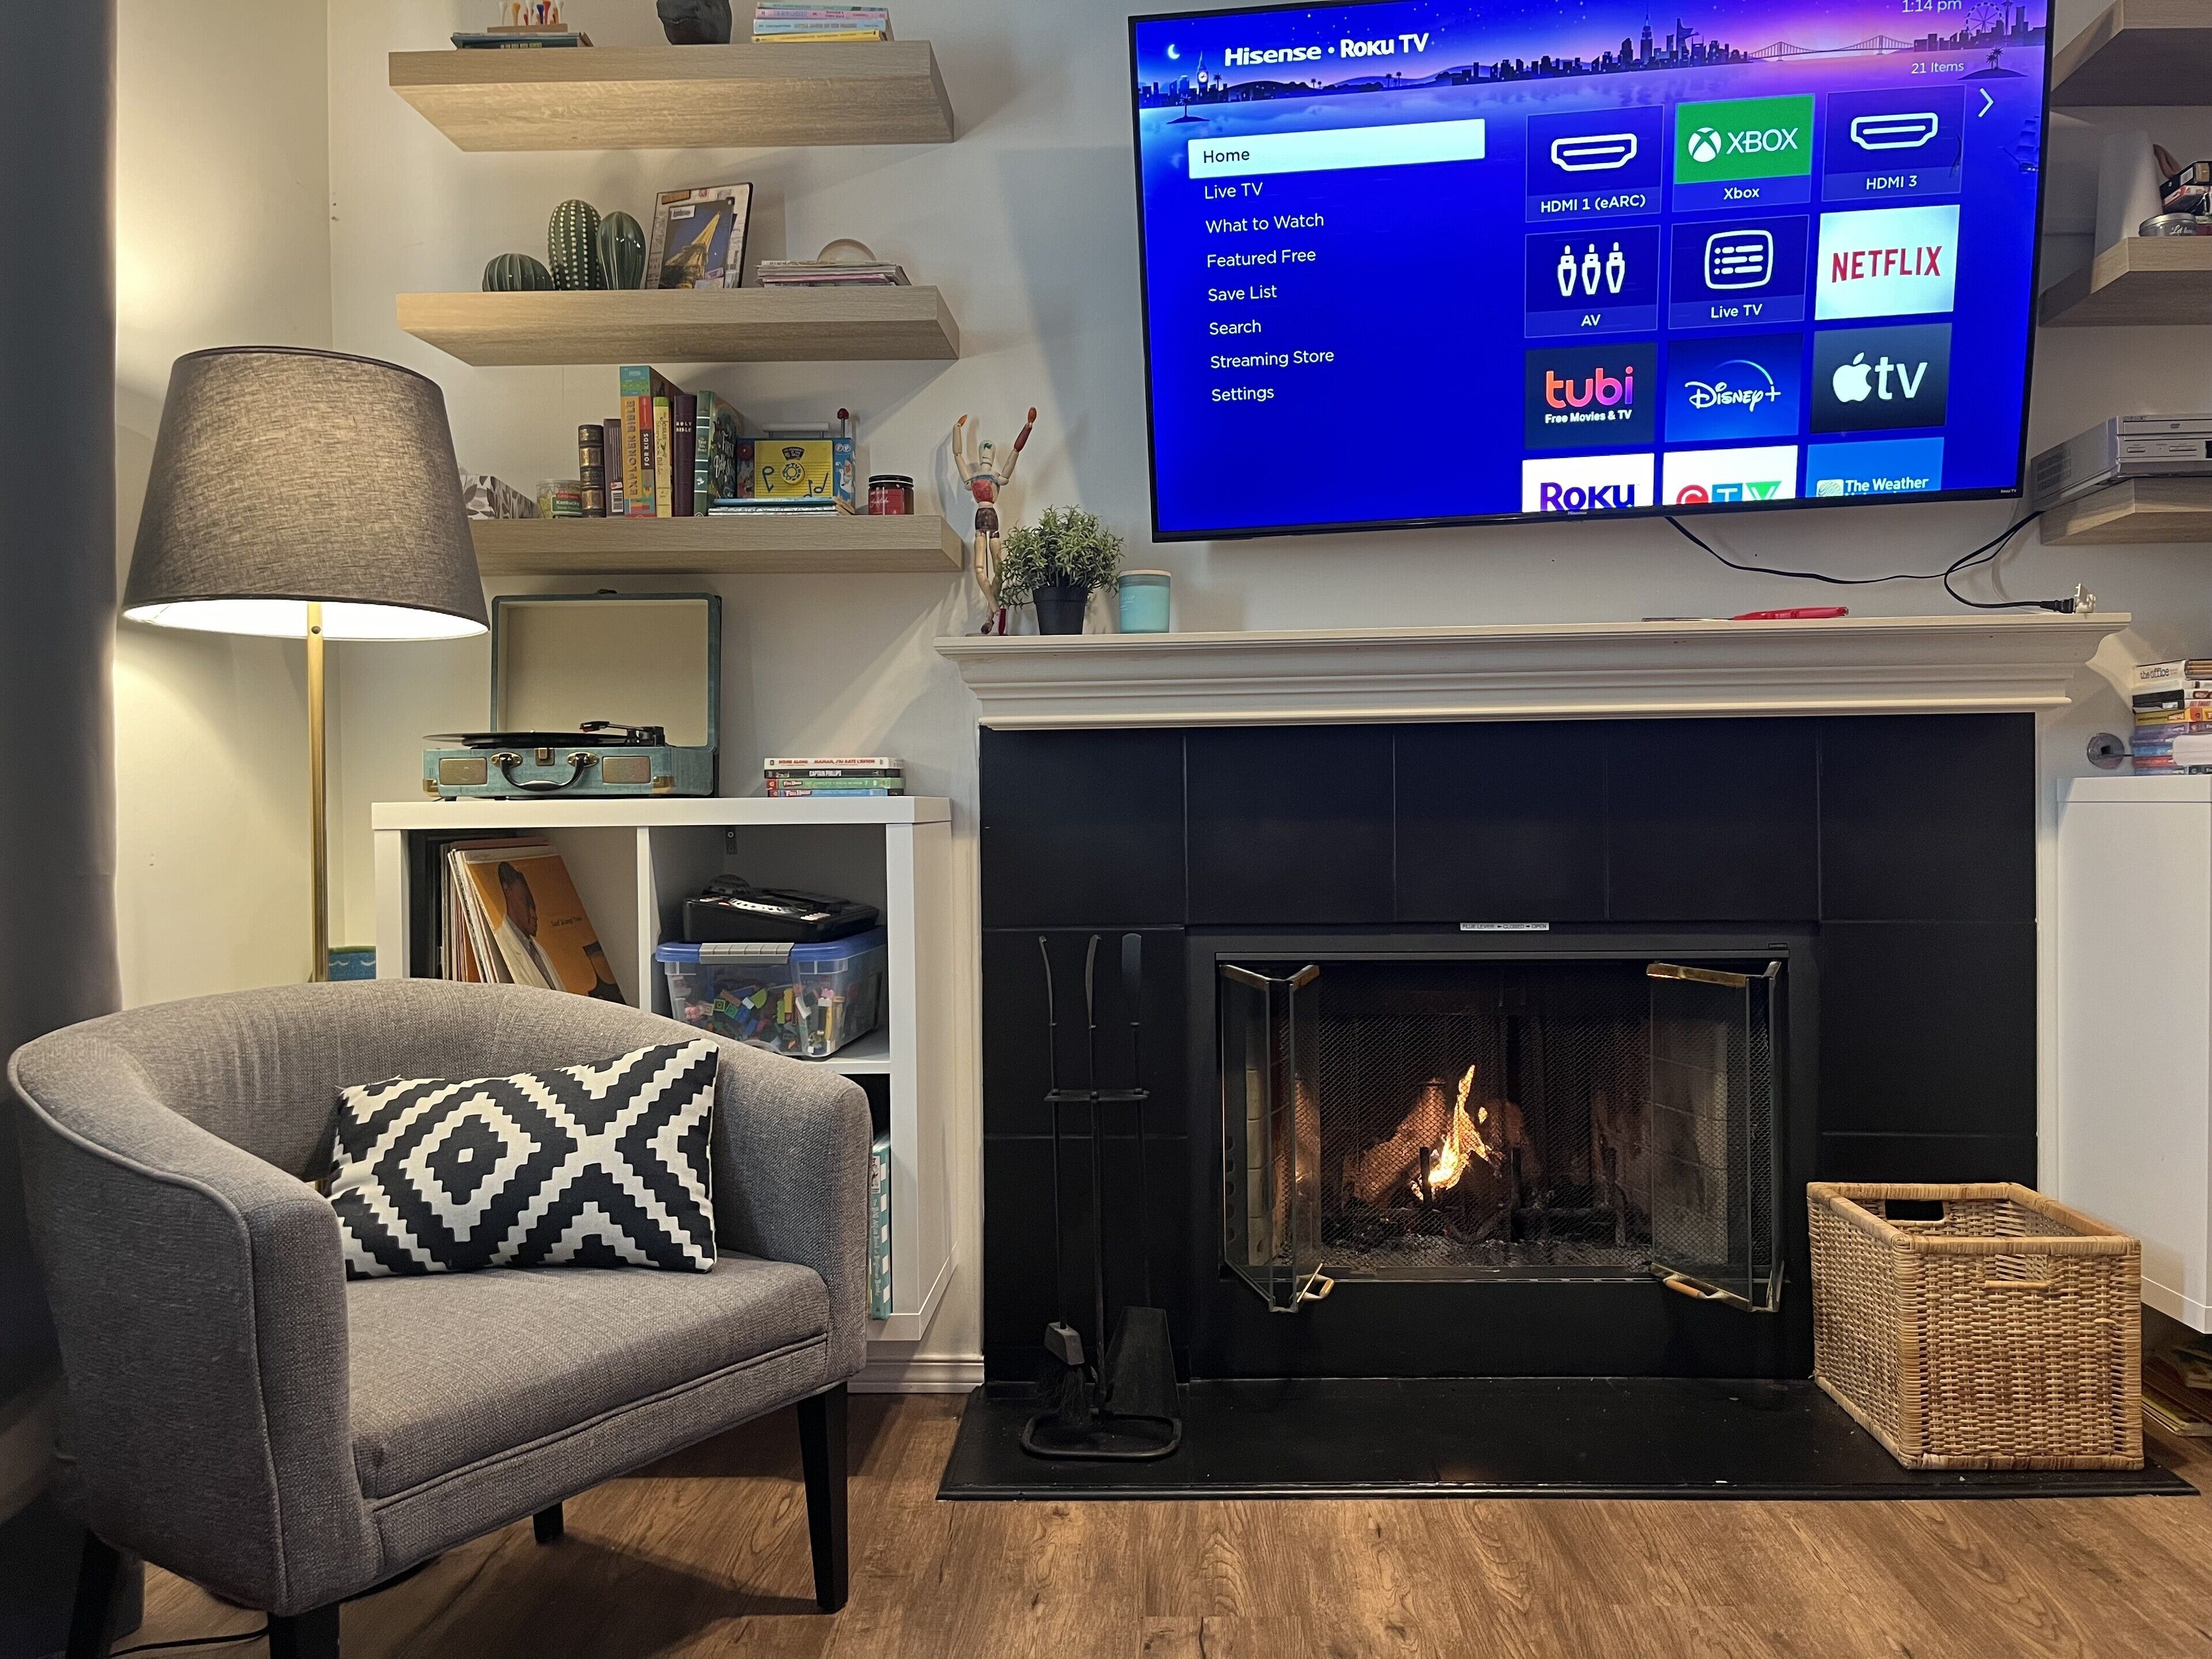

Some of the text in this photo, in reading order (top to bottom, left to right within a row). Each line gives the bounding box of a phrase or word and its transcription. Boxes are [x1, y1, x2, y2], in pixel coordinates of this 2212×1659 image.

[1902, 0, 1962, 13] 1:14 pm
[1224, 33, 1429, 67] Hisense Roku TV
[1911, 62, 1964, 74] 21 Items
[1727, 128, 1798, 154] XBOX
[1203, 149, 1250, 163] Home
[1204, 181, 1263, 199] Live TV
[1866, 176, 1917, 190] HDMI 3
[1724, 188, 1760, 200] Xbox
[1541, 195, 1646, 213] HDMI 1 (eARC)
[1206, 213, 1324, 233] What to Watch
[1207, 249, 1316, 267] Featured Free
[1832, 246, 1942, 283] NETFLIX
[1208, 285, 1277, 302] Save List
[1711, 304, 1763, 318] Live TV
[1209, 320, 1262, 335] Search
[1581, 315, 1601, 327] AV
[1210, 349, 1334, 369] Streaming Store
[1874, 356, 1928, 400] tv
[1211, 385, 1274, 402] Settings
[1546, 366, 1633, 408] tubi
[626, 400, 636, 432] BIBLE
[1545, 410, 1632, 423] Free Movies & TV
[1846, 478, 1929, 491] The Weather
[1540, 483, 1635, 512] Roku
[2140, 667, 2169, 679] the office
